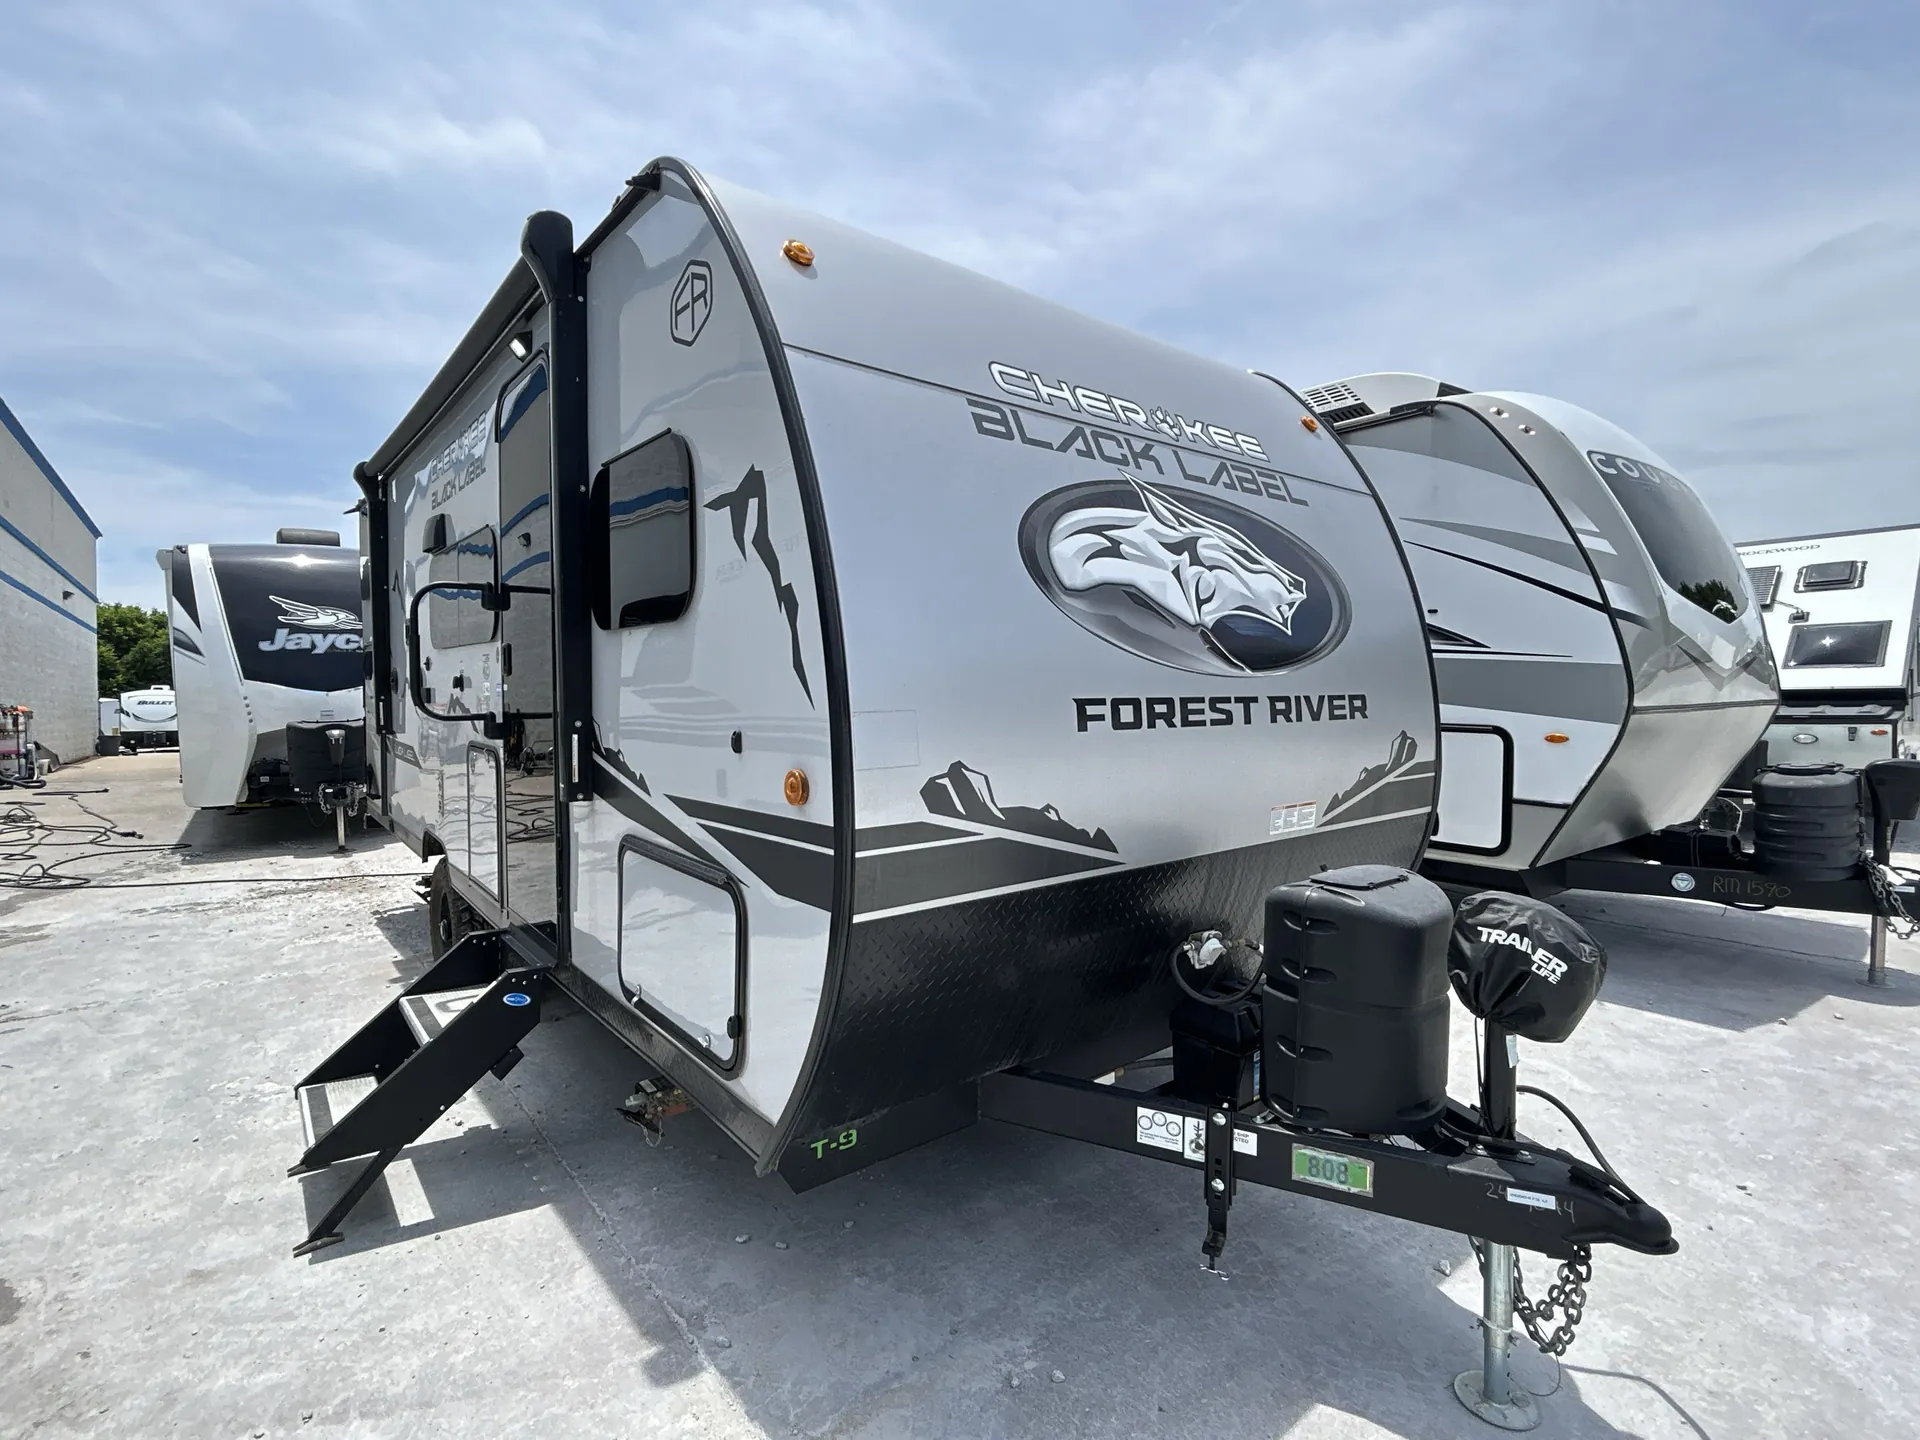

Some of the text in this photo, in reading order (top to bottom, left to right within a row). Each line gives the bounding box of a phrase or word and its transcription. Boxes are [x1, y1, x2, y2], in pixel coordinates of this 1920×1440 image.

[966, 398, 1309, 507] BLACK LABEL
[431, 455, 487, 511] BLACK LABEL
[258, 628, 363, 654] Jayc
[1072, 694, 1368, 732] FOREST RIVER
[1477, 926, 1568, 977] TRAILER
[1531, 963, 1561, 985] LIFE
[1308, 1155, 1349, 1185] 808
